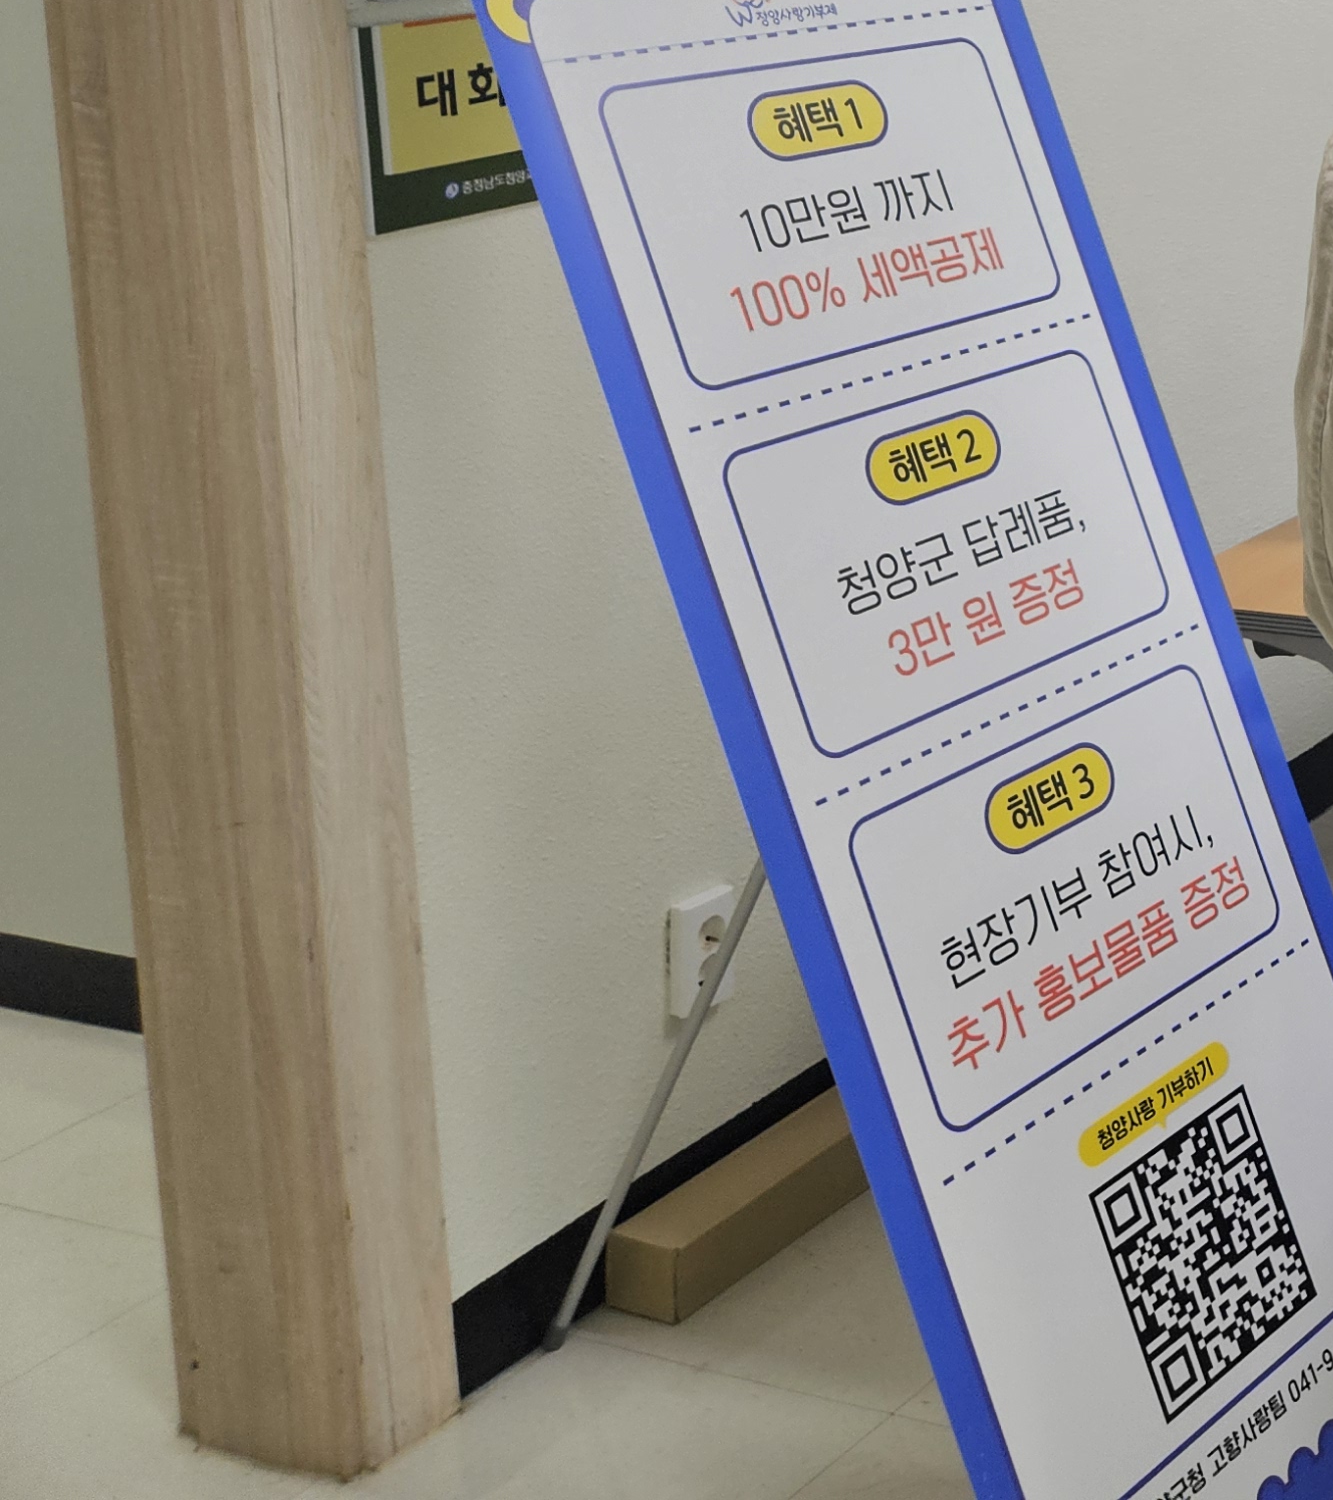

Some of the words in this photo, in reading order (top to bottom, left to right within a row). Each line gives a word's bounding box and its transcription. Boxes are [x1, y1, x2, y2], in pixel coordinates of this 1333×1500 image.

[773, 97, 845, 144] 혜택
[843, 99, 863, 130] 1
[739, 188, 871, 253] 10만원
[874, 169, 955, 224] 까지
[730, 266, 847, 333] 100%
[858, 227, 1005, 305] 세액공제
[888, 432, 958, 484] 혜택
[956, 428, 982, 462] 2
[836, 533, 960, 616] 청양군
[962, 489, 1088, 567] 답례품,
[887, 611, 956, 677] 3만
[962, 590, 1006, 646] 원
[1009, 558, 1086, 626] 증정
[1006, 772, 1076, 831] 혜택
[1072, 763, 1096, 800] 3
[940, 881, 1094, 990] 현장기부
[1097, 804, 1216, 898] 참여시,
[947, 989, 1027, 1072] 추가
[1033, 898, 1180, 1023] 홍보물품
[1180, 855, 1252, 931] 증정
[1097, 1096, 1158, 1152] 청양사랑
[1156, 1056, 1215, 1111] 기부하기
[1156, 1462, 1208, 1500] 군청
[1207, 1390, 1289, 1478] 고향사랑팀
